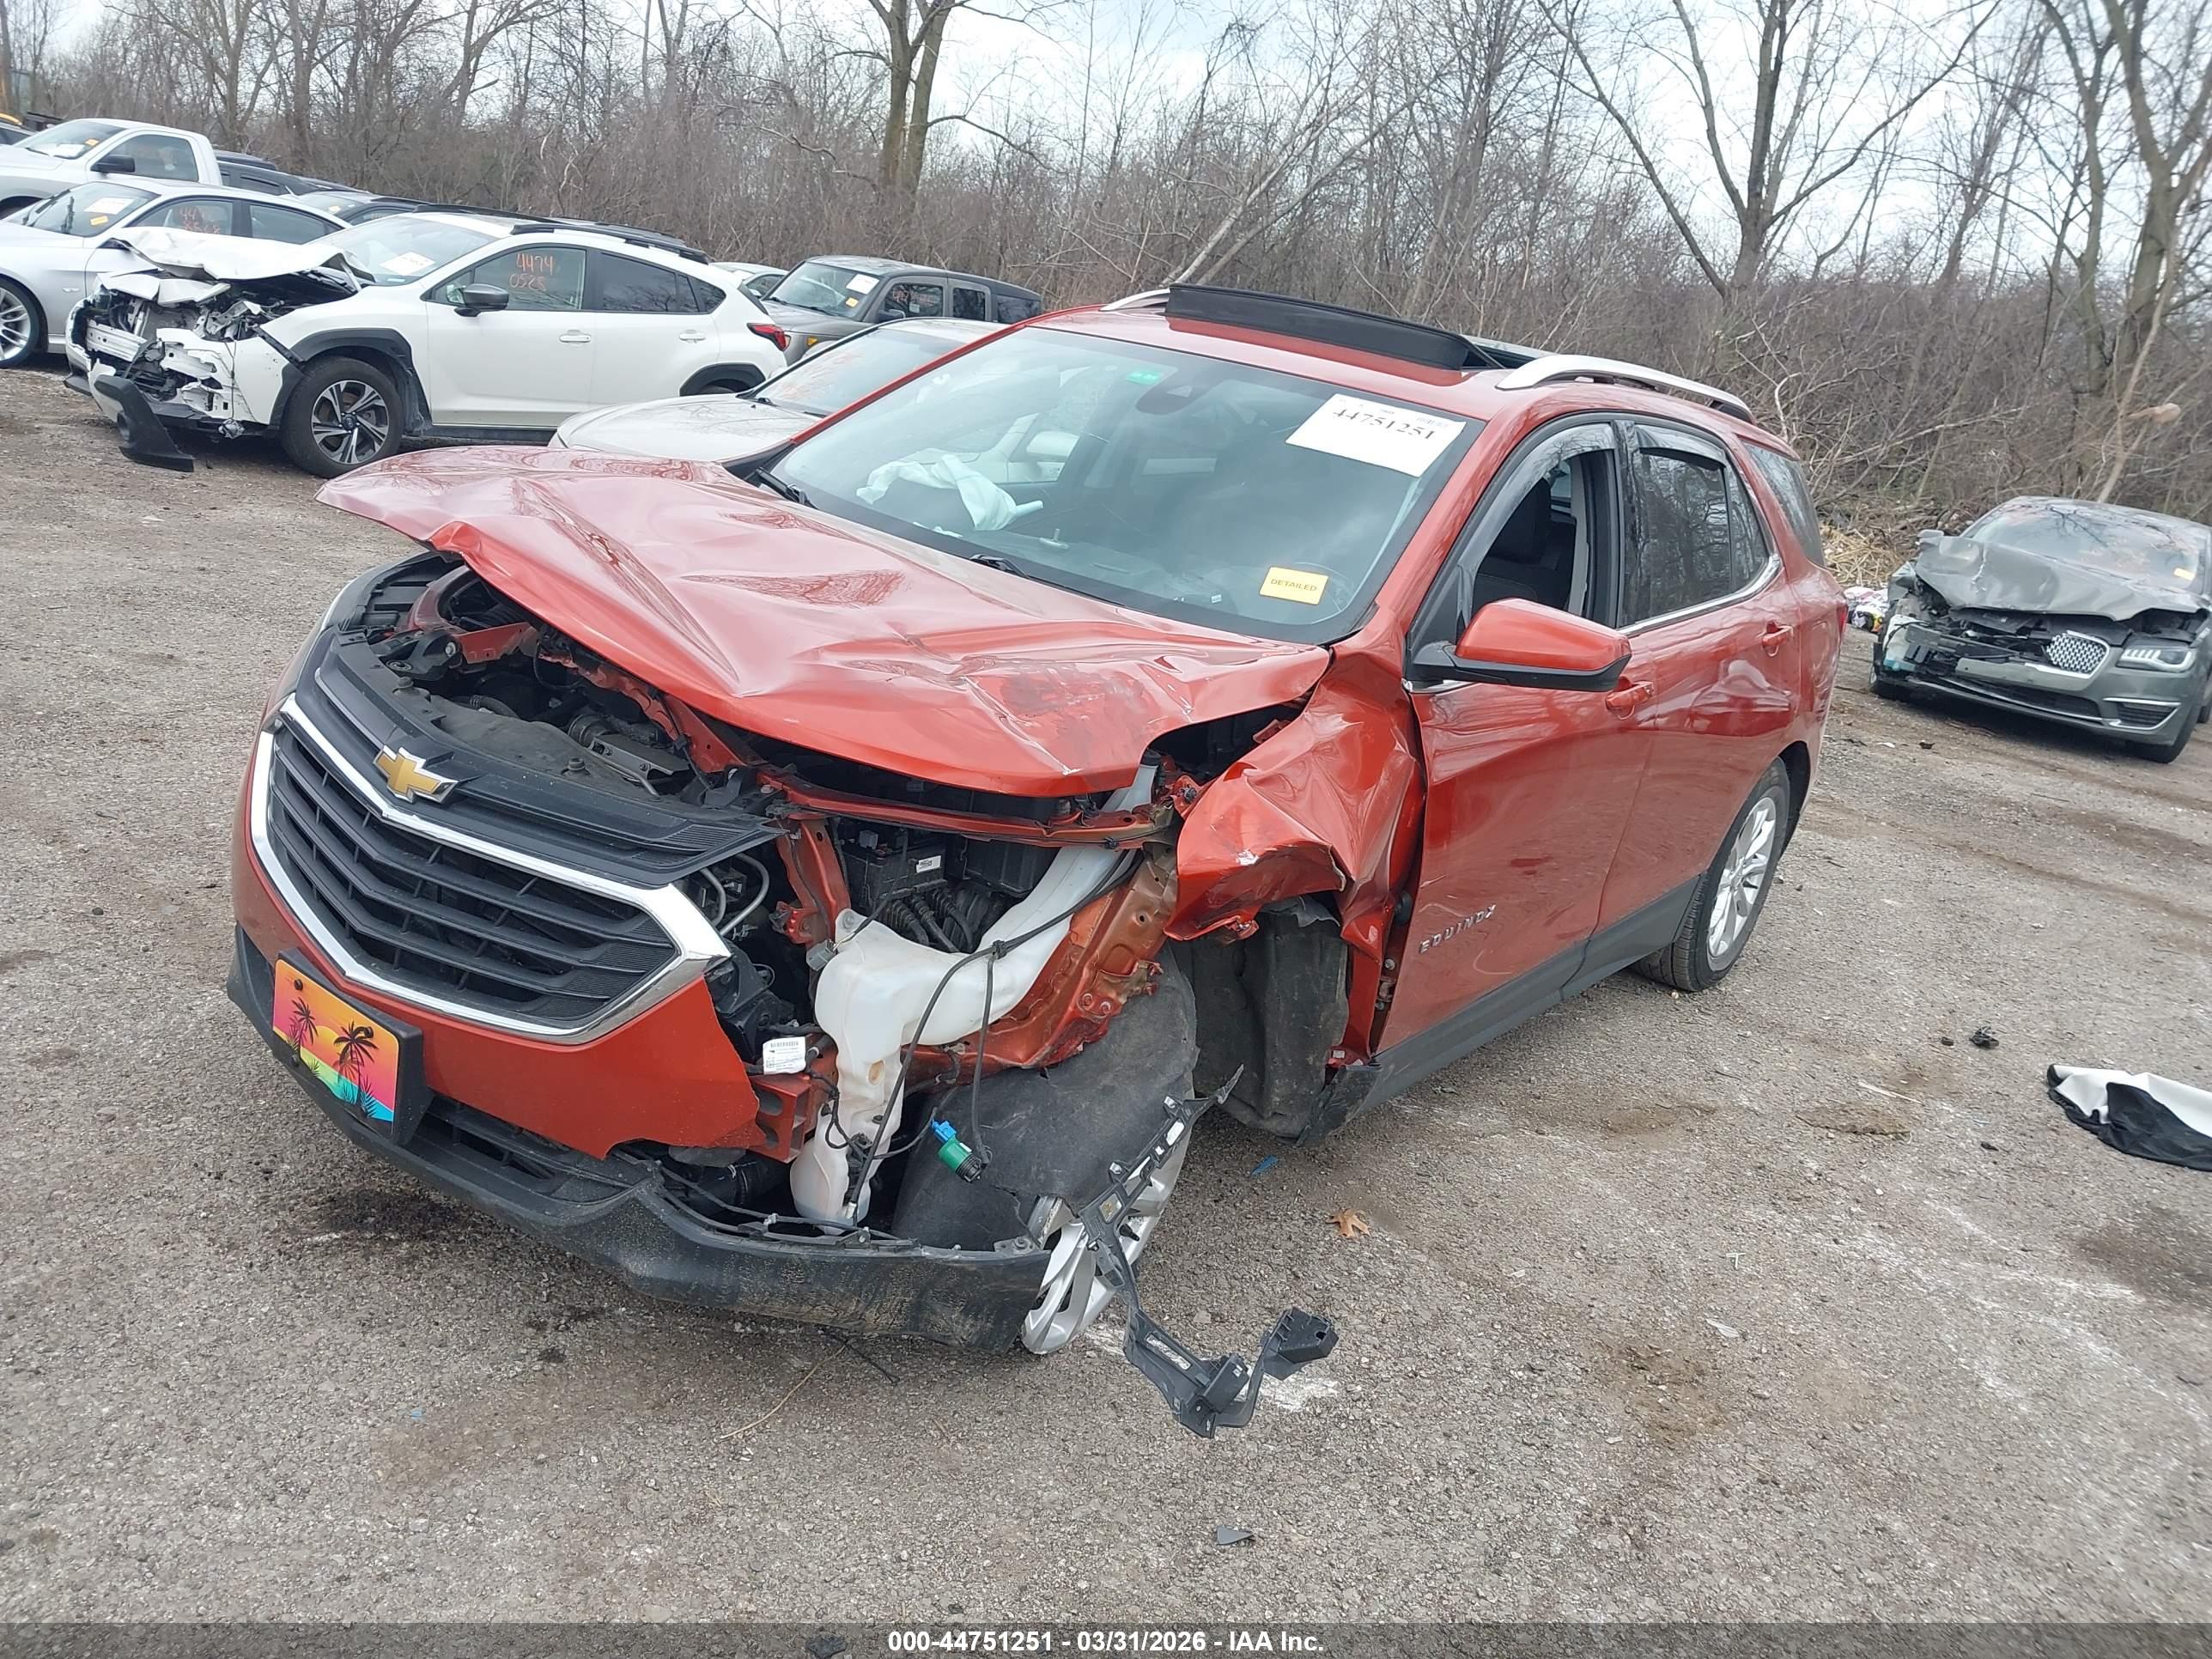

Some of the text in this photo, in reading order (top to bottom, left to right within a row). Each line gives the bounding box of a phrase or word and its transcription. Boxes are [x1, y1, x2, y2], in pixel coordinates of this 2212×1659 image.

[1333, 409, 1435, 440] 44751251
[1271, 578, 1317, 592] DETAILED
[1419, 903, 1496, 953] EQUINOX
